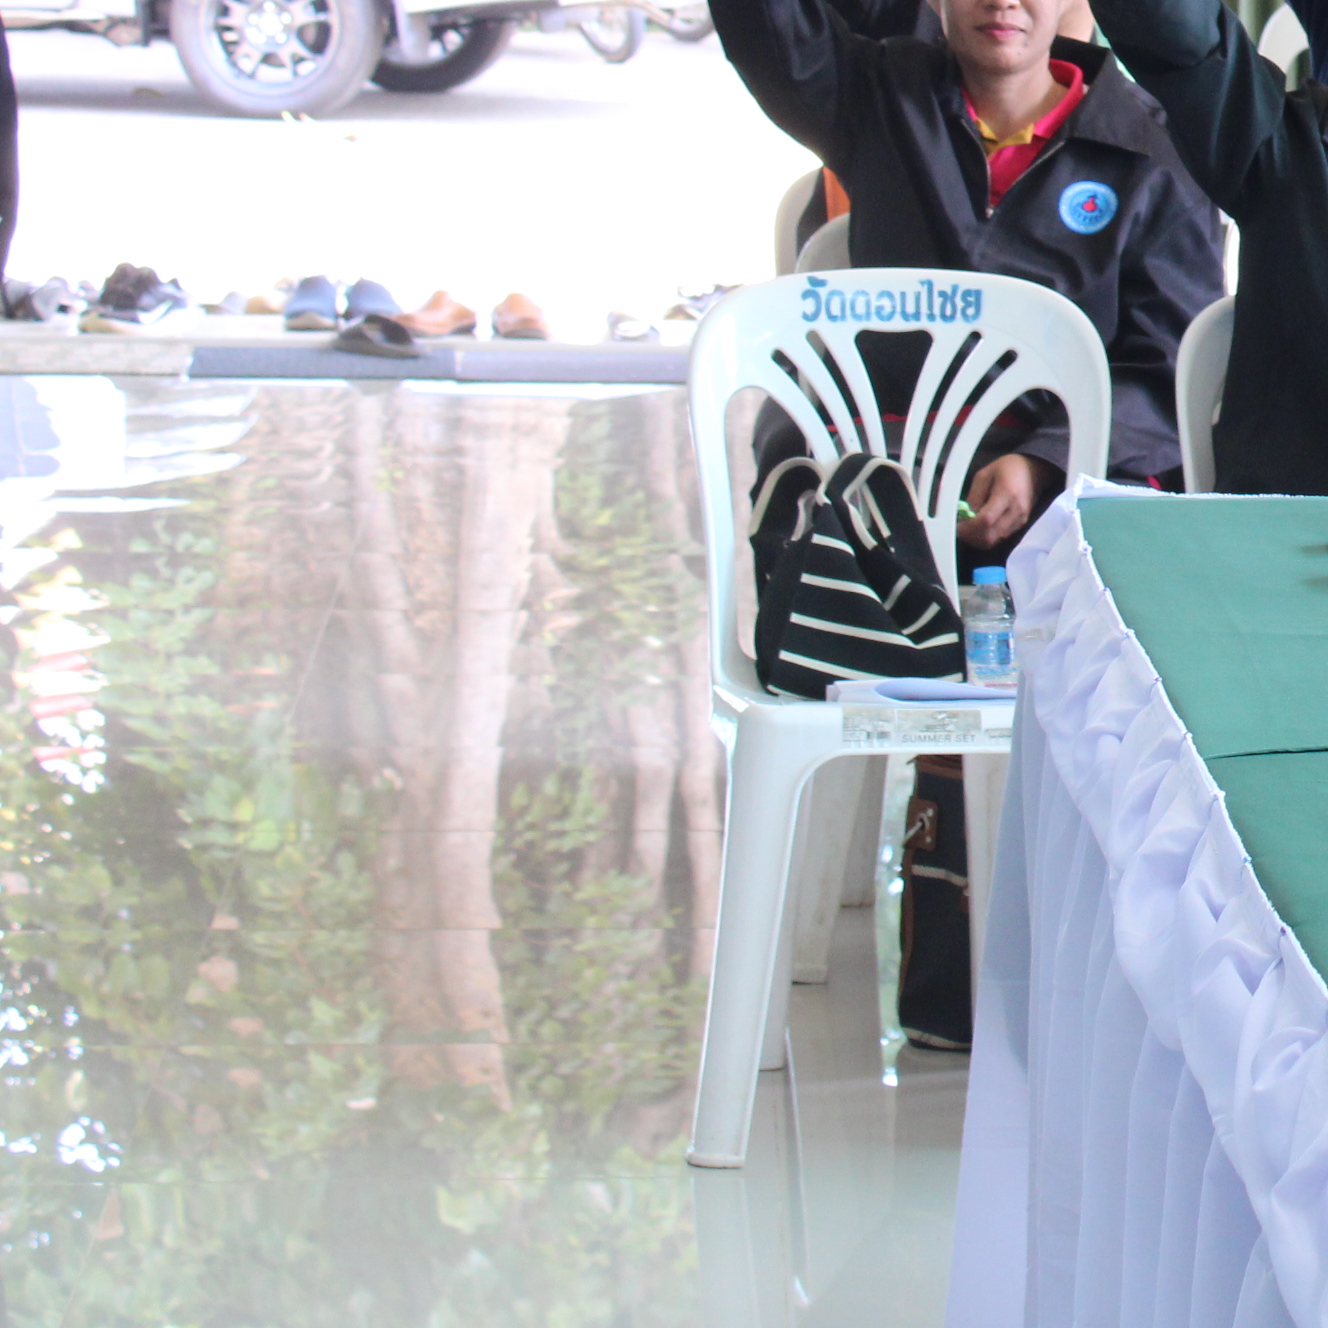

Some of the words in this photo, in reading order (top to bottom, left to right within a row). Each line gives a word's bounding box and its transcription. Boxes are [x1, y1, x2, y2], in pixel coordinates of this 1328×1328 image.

[800, 275, 983, 323] วัดดอนไชย
[901, 734, 951, 743] SUMMER
[955, 734, 976, 743] SET
